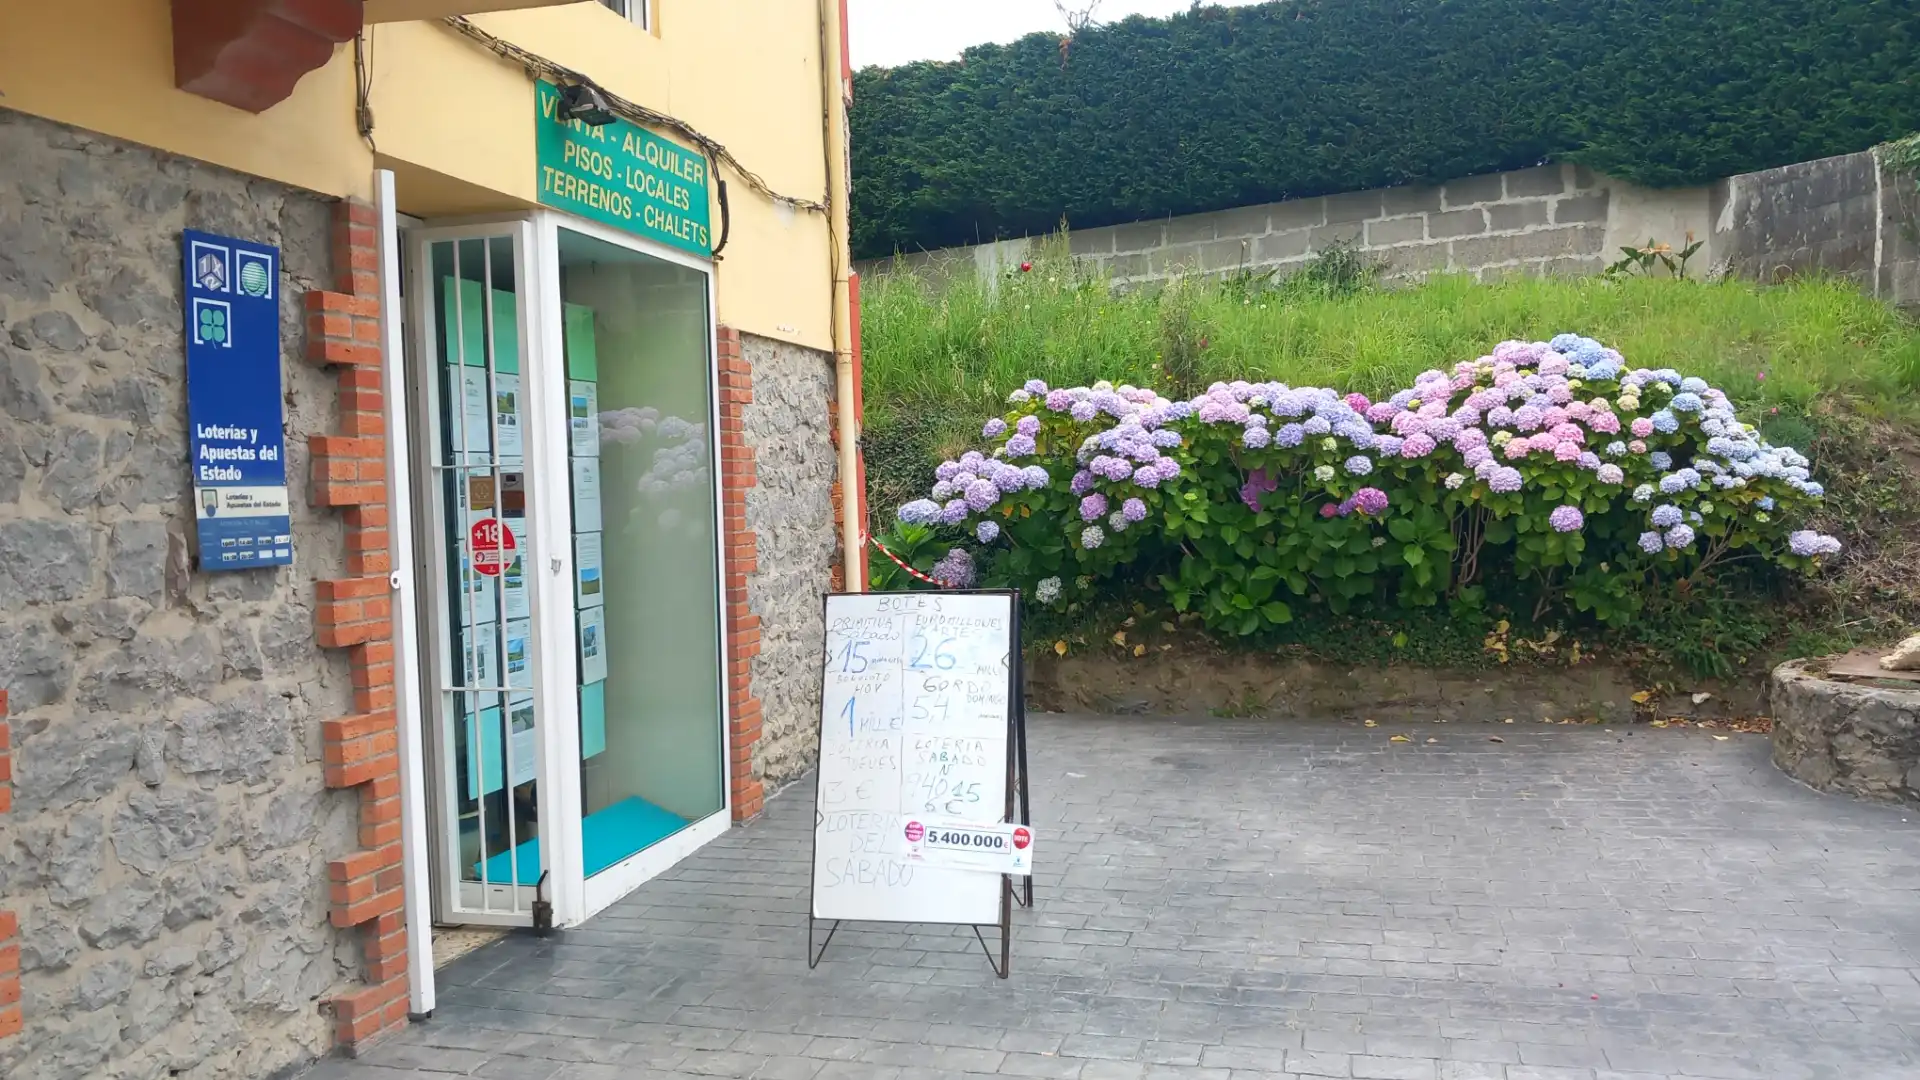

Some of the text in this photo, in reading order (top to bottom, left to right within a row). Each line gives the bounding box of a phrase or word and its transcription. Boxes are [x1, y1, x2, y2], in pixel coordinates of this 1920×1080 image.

[622, 131, 704, 187] ALQUILER
[564, 139, 613, 181] PISOS
[626, 166, 690, 211] LOCALES
[543, 166, 632, 220] TERRENOS
[644, 205, 708, 248] CHALETS
[197, 423, 258, 444] Loterías y
[200, 444, 278, 463] Apuestas del
[200, 466, 242, 481] Estado
[263, 500, 281, 508] Estado
[877, 596, 943, 612] BOTES
[831, 617, 893, 631] PRIMITIVA
[916, 614, 1003, 631] EUROMILLONES
[838, 640, 871, 674] 15
[910, 634, 957, 670] 26
[855, 683, 882, 694] HOY
[840, 696, 856, 738] 1
[912, 694, 950, 723] 5,4
[915, 737, 983, 752] LOTERIA
[916, 751, 987, 767] SABADO
[826, 813, 901, 833] LOTERIA
[850, 833, 894, 854] DEL
